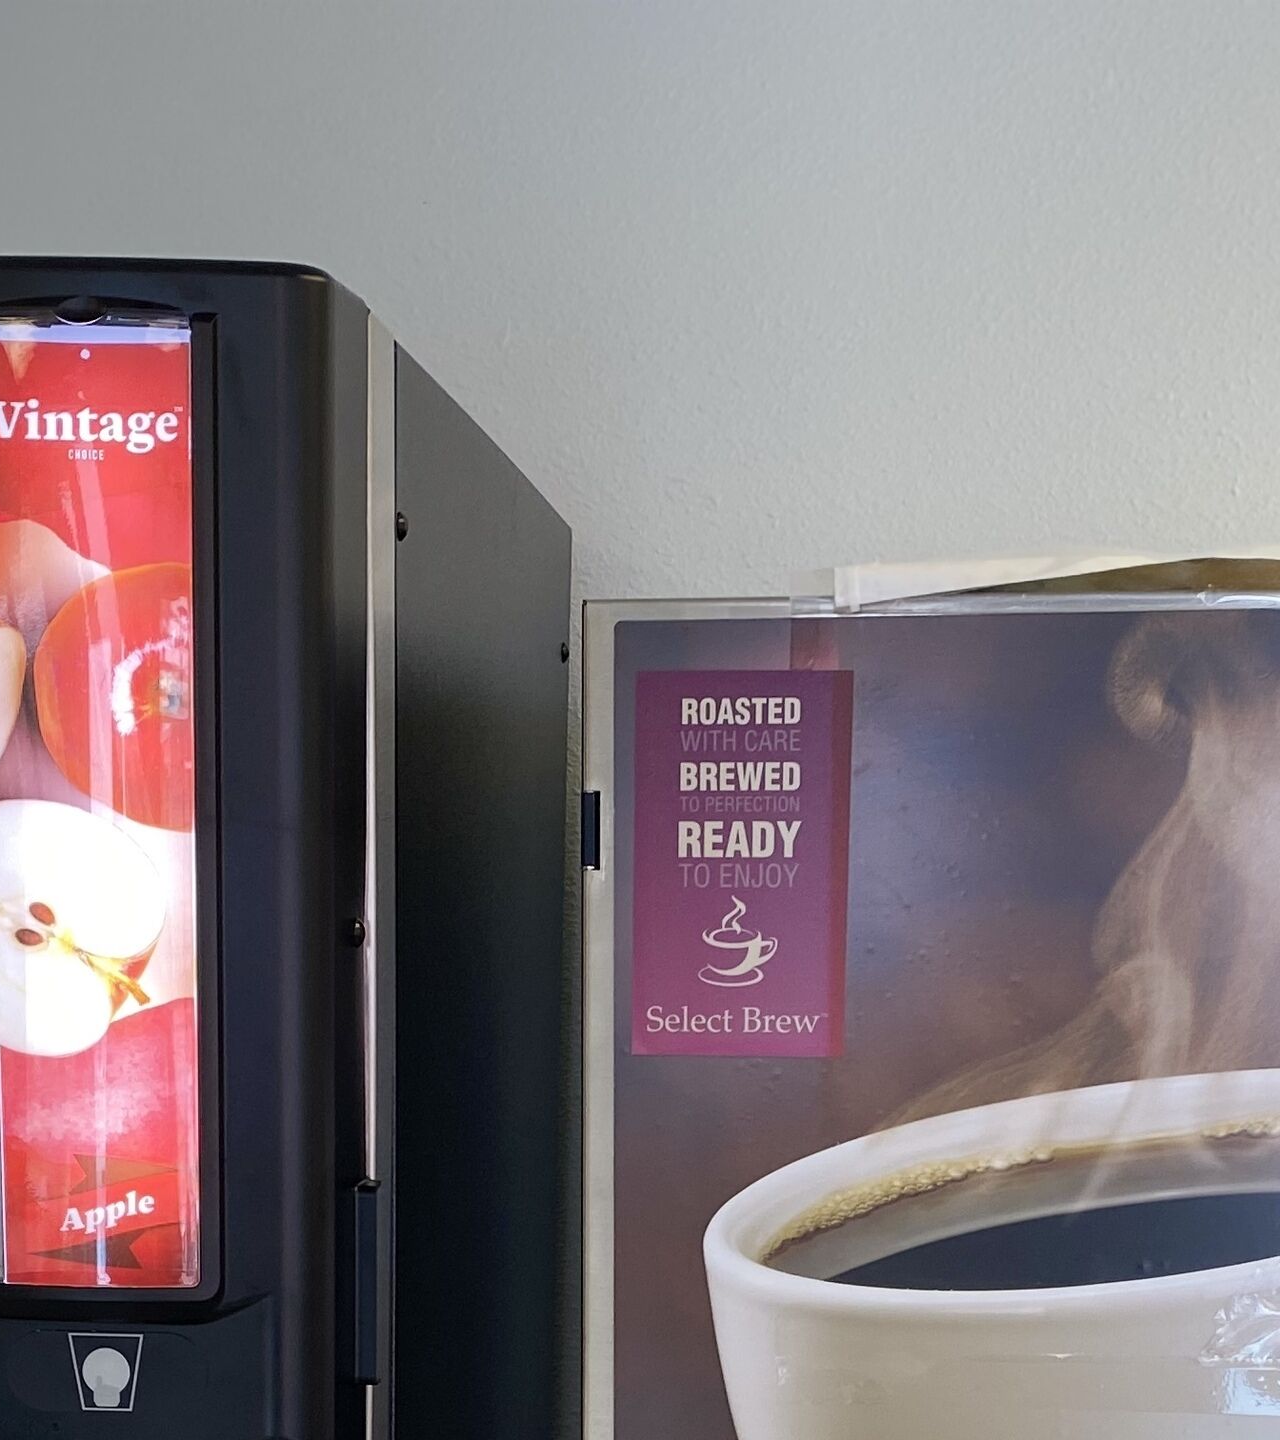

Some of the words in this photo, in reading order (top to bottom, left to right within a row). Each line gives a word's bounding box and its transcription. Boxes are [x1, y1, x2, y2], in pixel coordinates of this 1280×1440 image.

[67, 448, 105, 461] CHOICE
[681, 697, 801, 725] ROASTED
[680, 730, 737, 752] WITH
[744, 730, 801, 752] CARE
[679, 761, 801, 791] BREWED
[680, 796, 700, 812] TO
[705, 796, 801, 813] PERFECTION
[678, 820, 802, 858] READY
[678, 863, 710, 888] TO
[720, 863, 800, 888] ENJOY
[646, 1006, 733, 1034] Select
[742, 1006, 820, 1034] Brew
[59, 1190, 156, 1234] Apple
